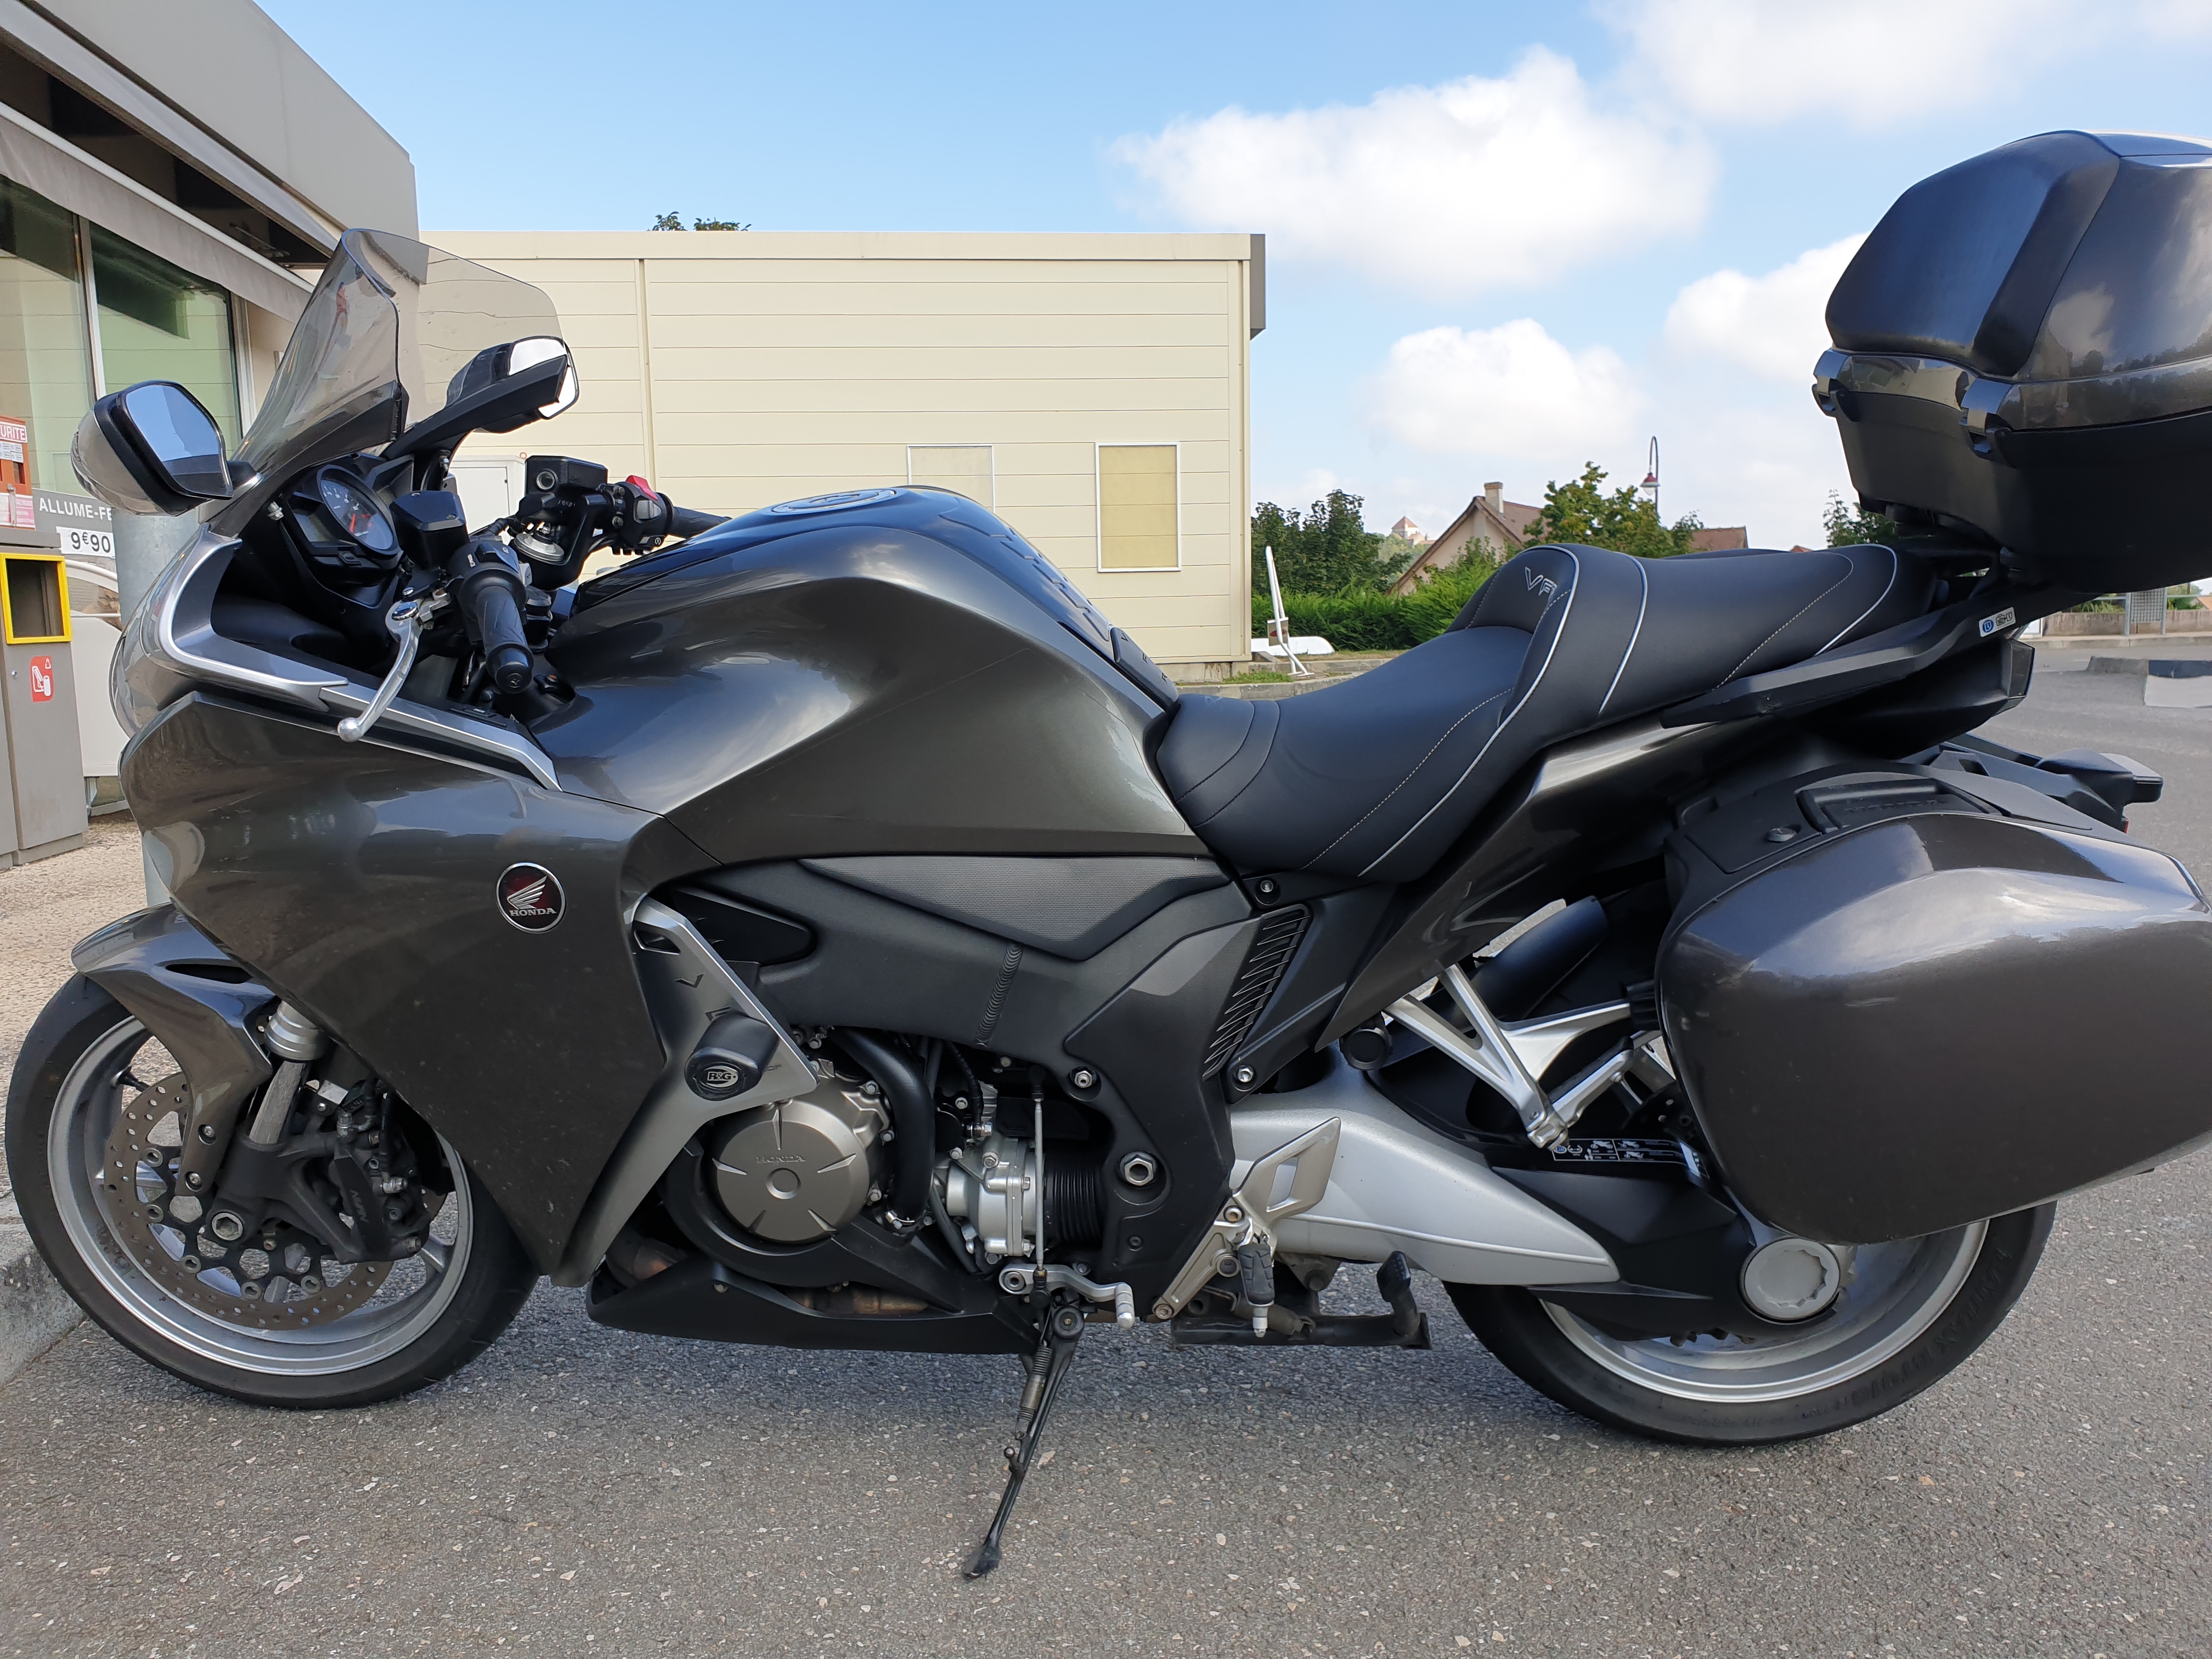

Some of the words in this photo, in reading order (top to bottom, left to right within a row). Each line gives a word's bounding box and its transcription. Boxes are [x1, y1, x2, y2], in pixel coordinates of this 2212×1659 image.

[71, 532, 110, 553] 9€90
[509, 908, 557, 916] HONDA
[708, 1071, 732, 1081] R&G
[756, 1155, 806, 1164] HONDA
